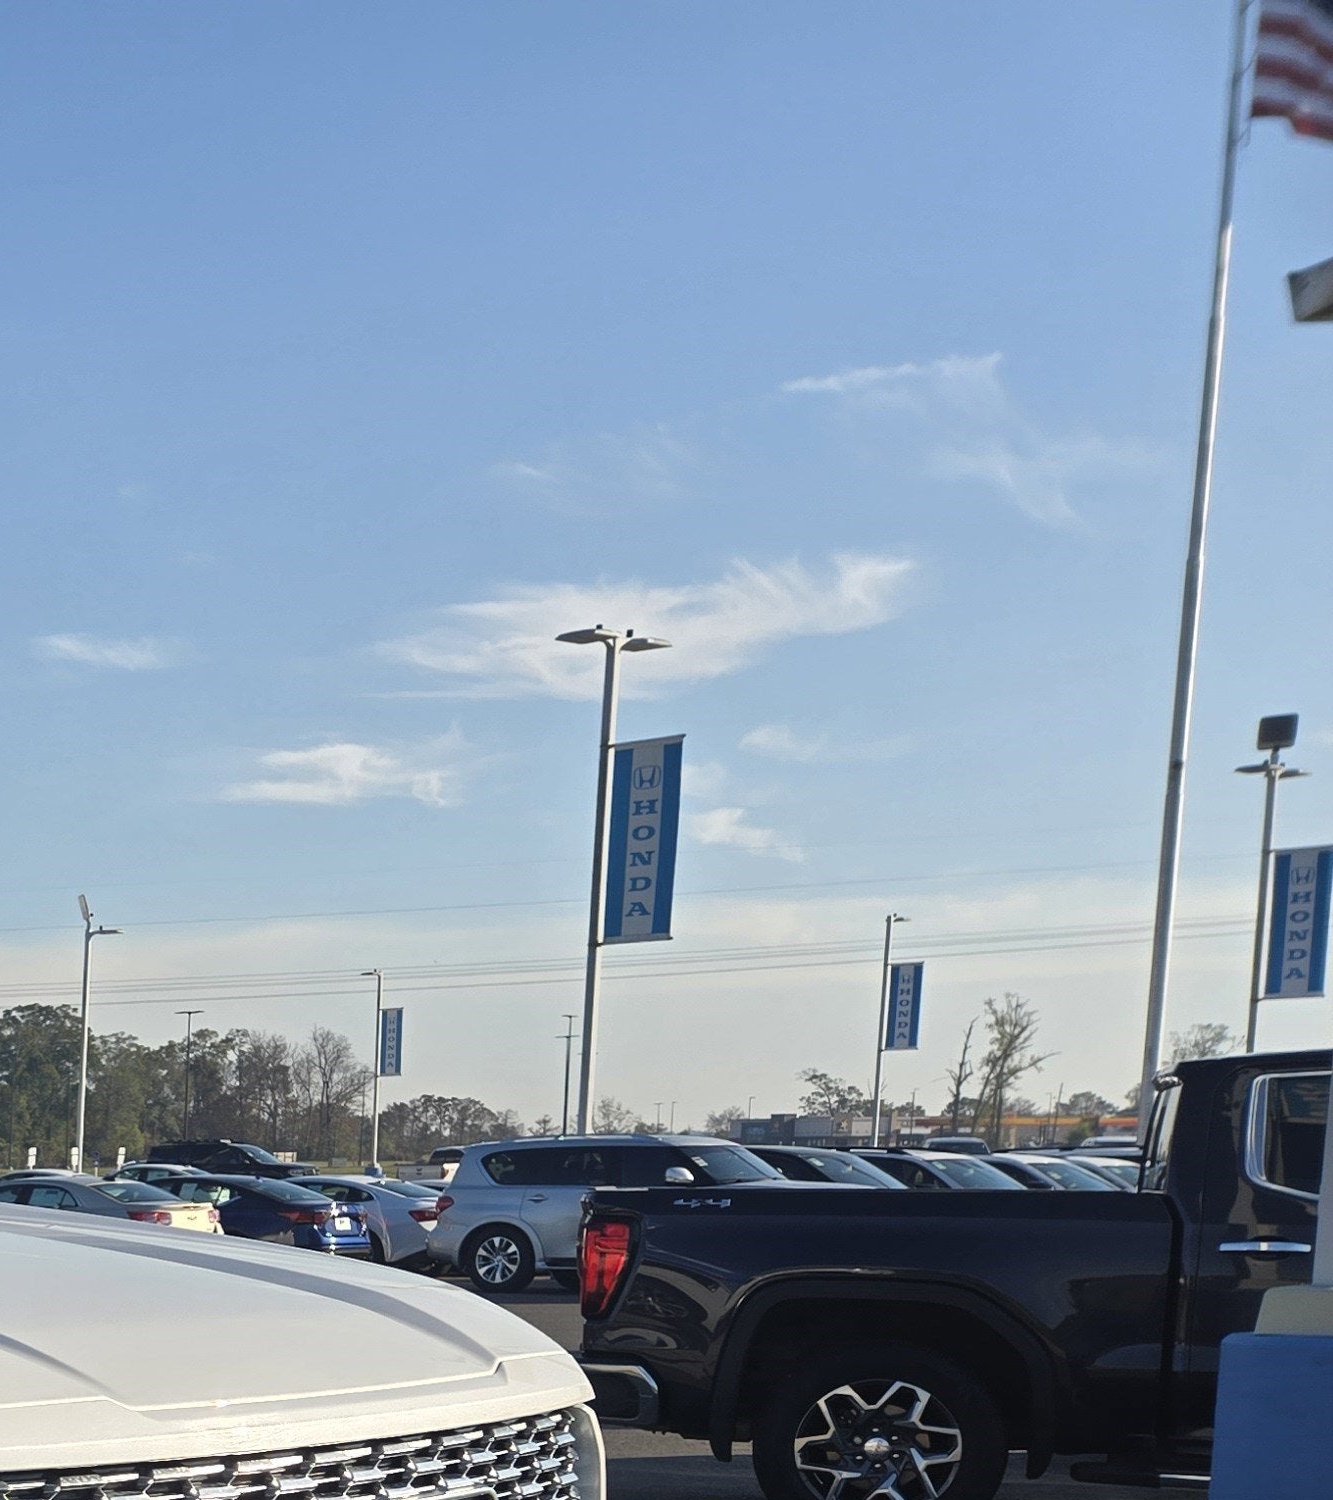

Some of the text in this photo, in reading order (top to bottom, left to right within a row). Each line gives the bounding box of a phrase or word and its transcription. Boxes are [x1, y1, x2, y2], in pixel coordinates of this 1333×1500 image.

[625, 799, 658, 917] HONDA
[1285, 890, 1313, 980] HONDA
[896, 988, 911, 1039] HONDA
